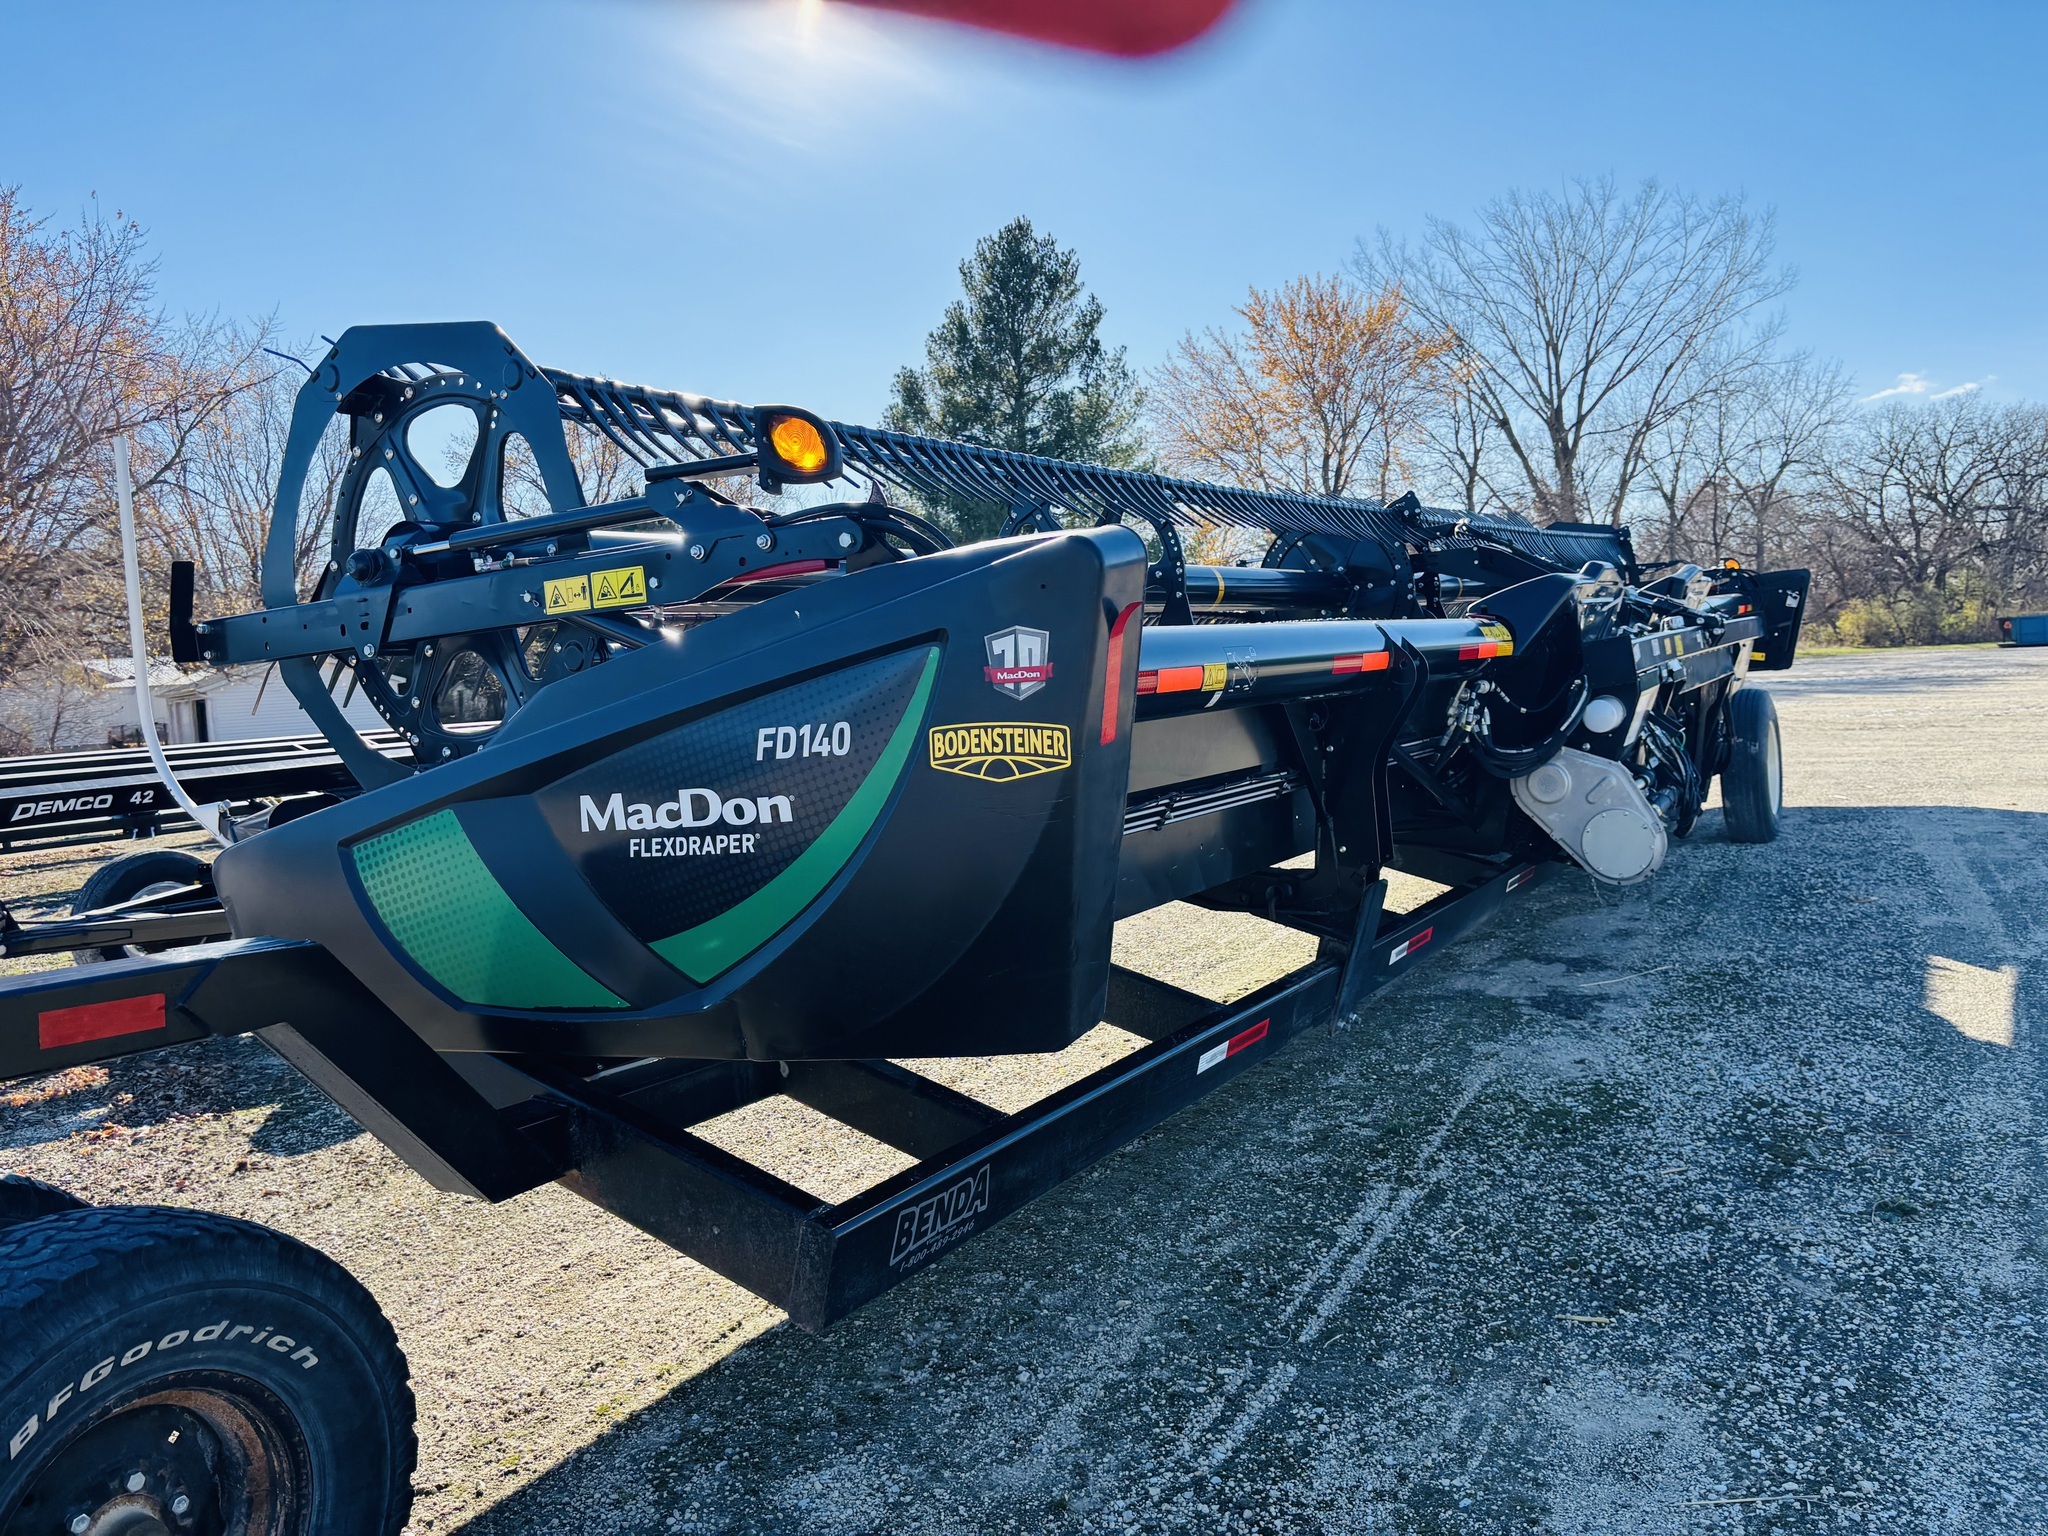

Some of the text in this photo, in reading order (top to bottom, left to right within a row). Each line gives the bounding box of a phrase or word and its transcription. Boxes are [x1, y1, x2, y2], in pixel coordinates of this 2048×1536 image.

[997, 670, 1041, 680] MacDon
[756, 721, 851, 761] FD140
[933, 727, 1067, 758] BODENSTEINER
[10, 790, 154, 822] DEMCO 42
[889, 1163, 990, 1267] BENDA
[9, 1320, 319, 1460] BFGoodrich
